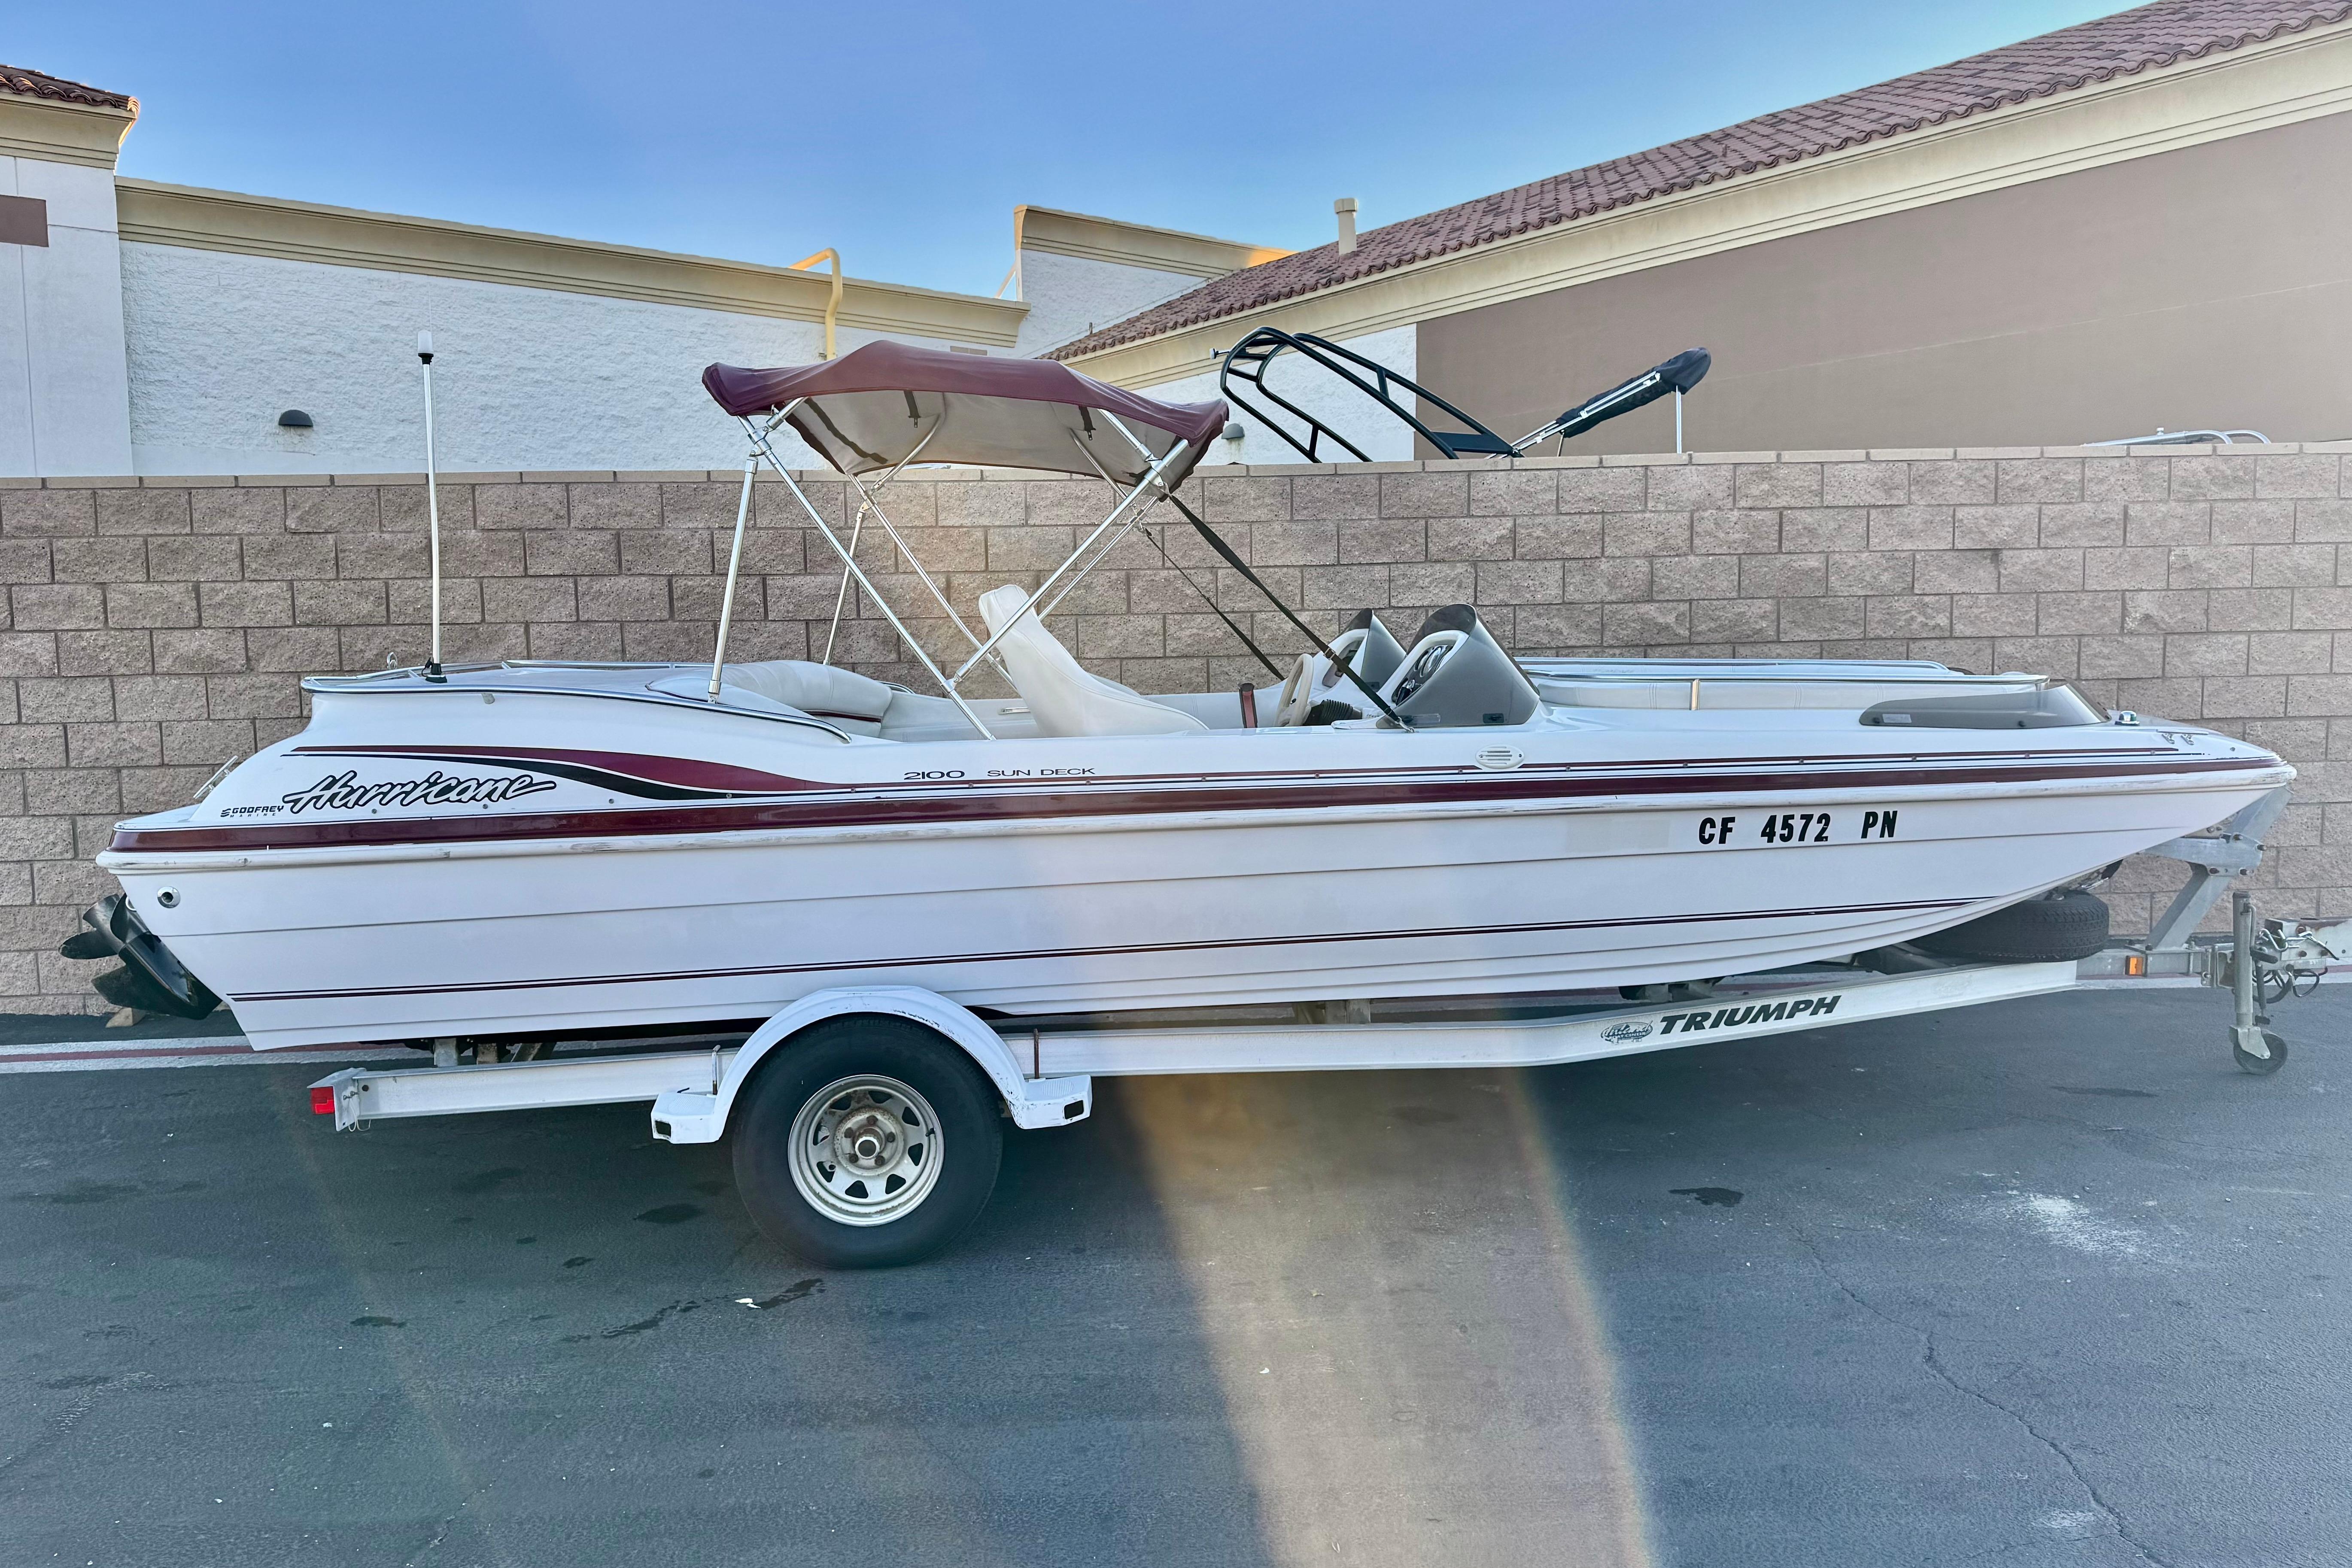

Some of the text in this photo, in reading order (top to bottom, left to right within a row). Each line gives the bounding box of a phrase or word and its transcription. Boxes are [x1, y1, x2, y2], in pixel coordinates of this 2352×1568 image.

[282, 769, 557, 814] Hurricane
[903, 770, 965, 780] 2100
[232, 805, 284, 814] GODFREY
[1699, 810, 1898, 845] CF 4572 PN
[1660, 995, 1841, 1035] TRIUMPH
